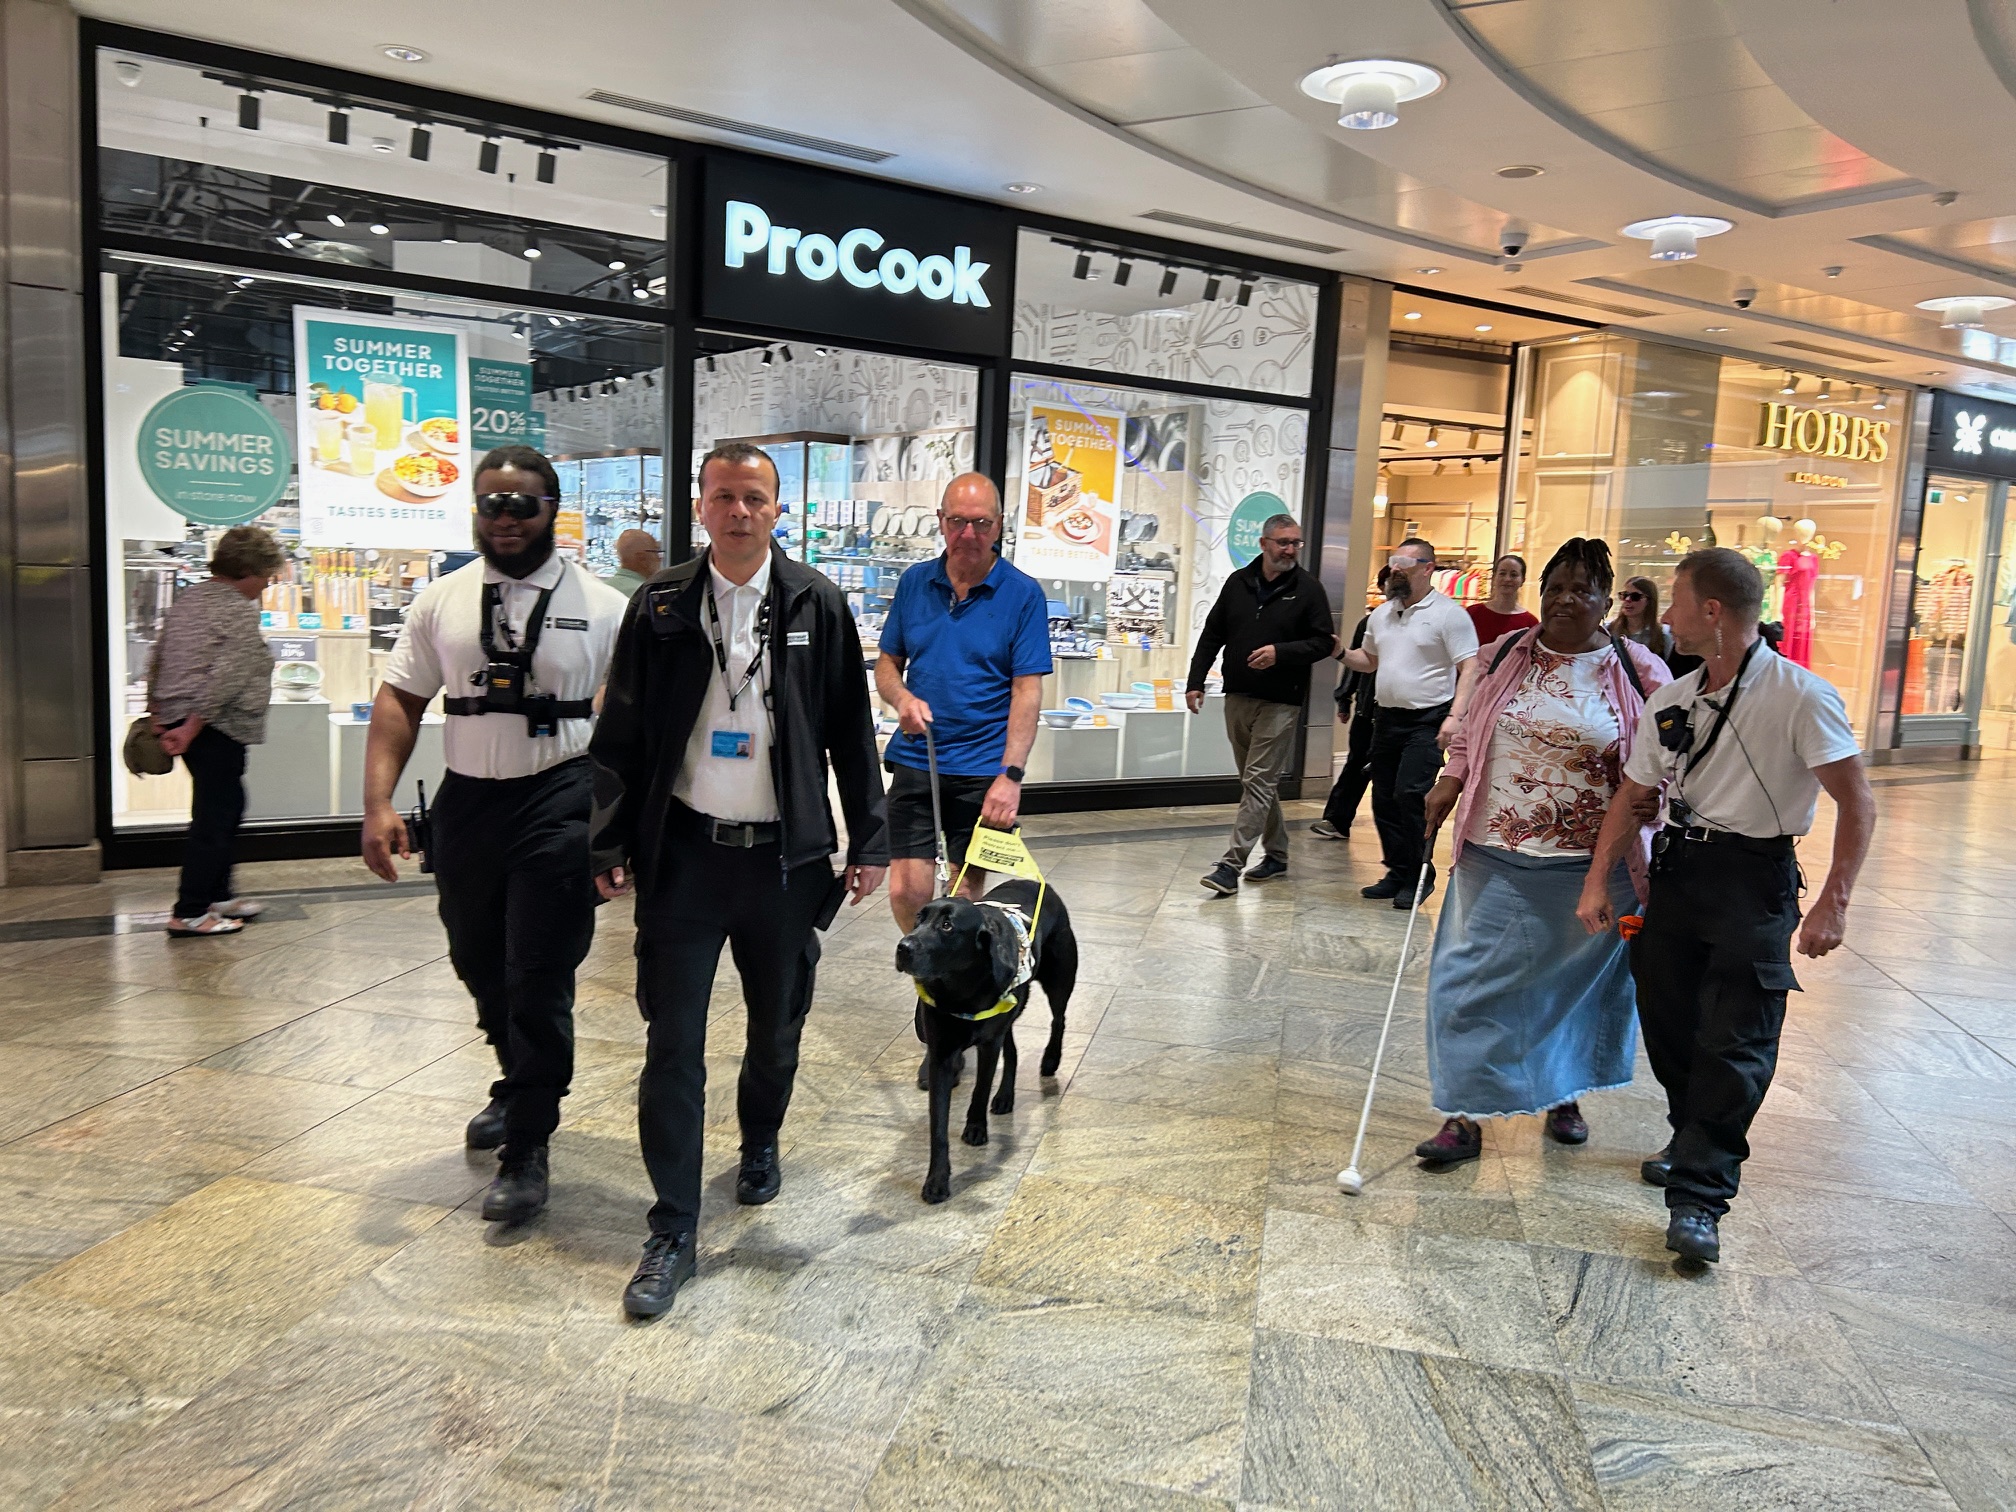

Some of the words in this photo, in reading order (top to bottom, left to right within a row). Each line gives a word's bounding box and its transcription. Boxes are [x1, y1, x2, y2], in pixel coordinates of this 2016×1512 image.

[725, 200, 992, 308] ProCook
[333, 337, 432, 360] SUMMER
[322, 354, 443, 379] TOGETHER
[472, 407, 527, 434] 20%
[1054, 418, 1112, 437] SUMMER
[1763, 401, 1891, 463] HOBBS
[155, 427, 274, 455] SUMMER
[1048, 432, 1114, 452] TOGETHER
[154, 450, 275, 476] SAVINGS
[327, 506, 386, 518] TASTES
[390, 508, 447, 520] BETTER
